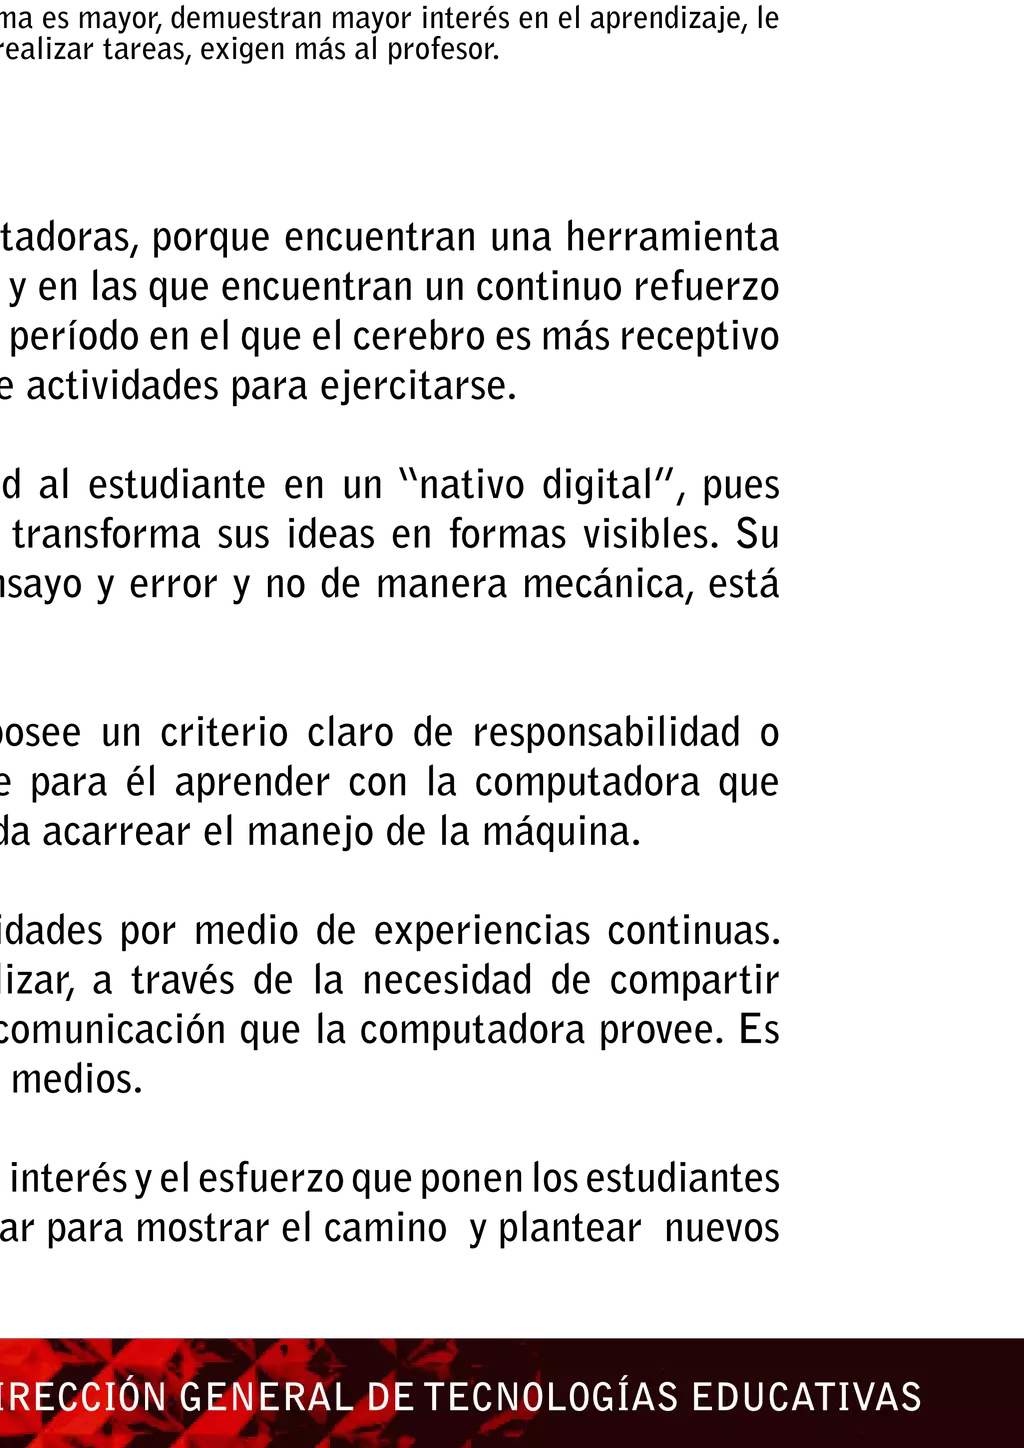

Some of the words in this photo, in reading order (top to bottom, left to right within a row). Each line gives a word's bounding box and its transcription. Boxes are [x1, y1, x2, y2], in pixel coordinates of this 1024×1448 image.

[180, 1381, 354, 1411] GENERAL
[369, 1381, 414, 1411] DE
[423, 1374, 678, 1412] TECNOLOGÍAS
[693, 1381, 921, 1412] EDUCATIVAS
